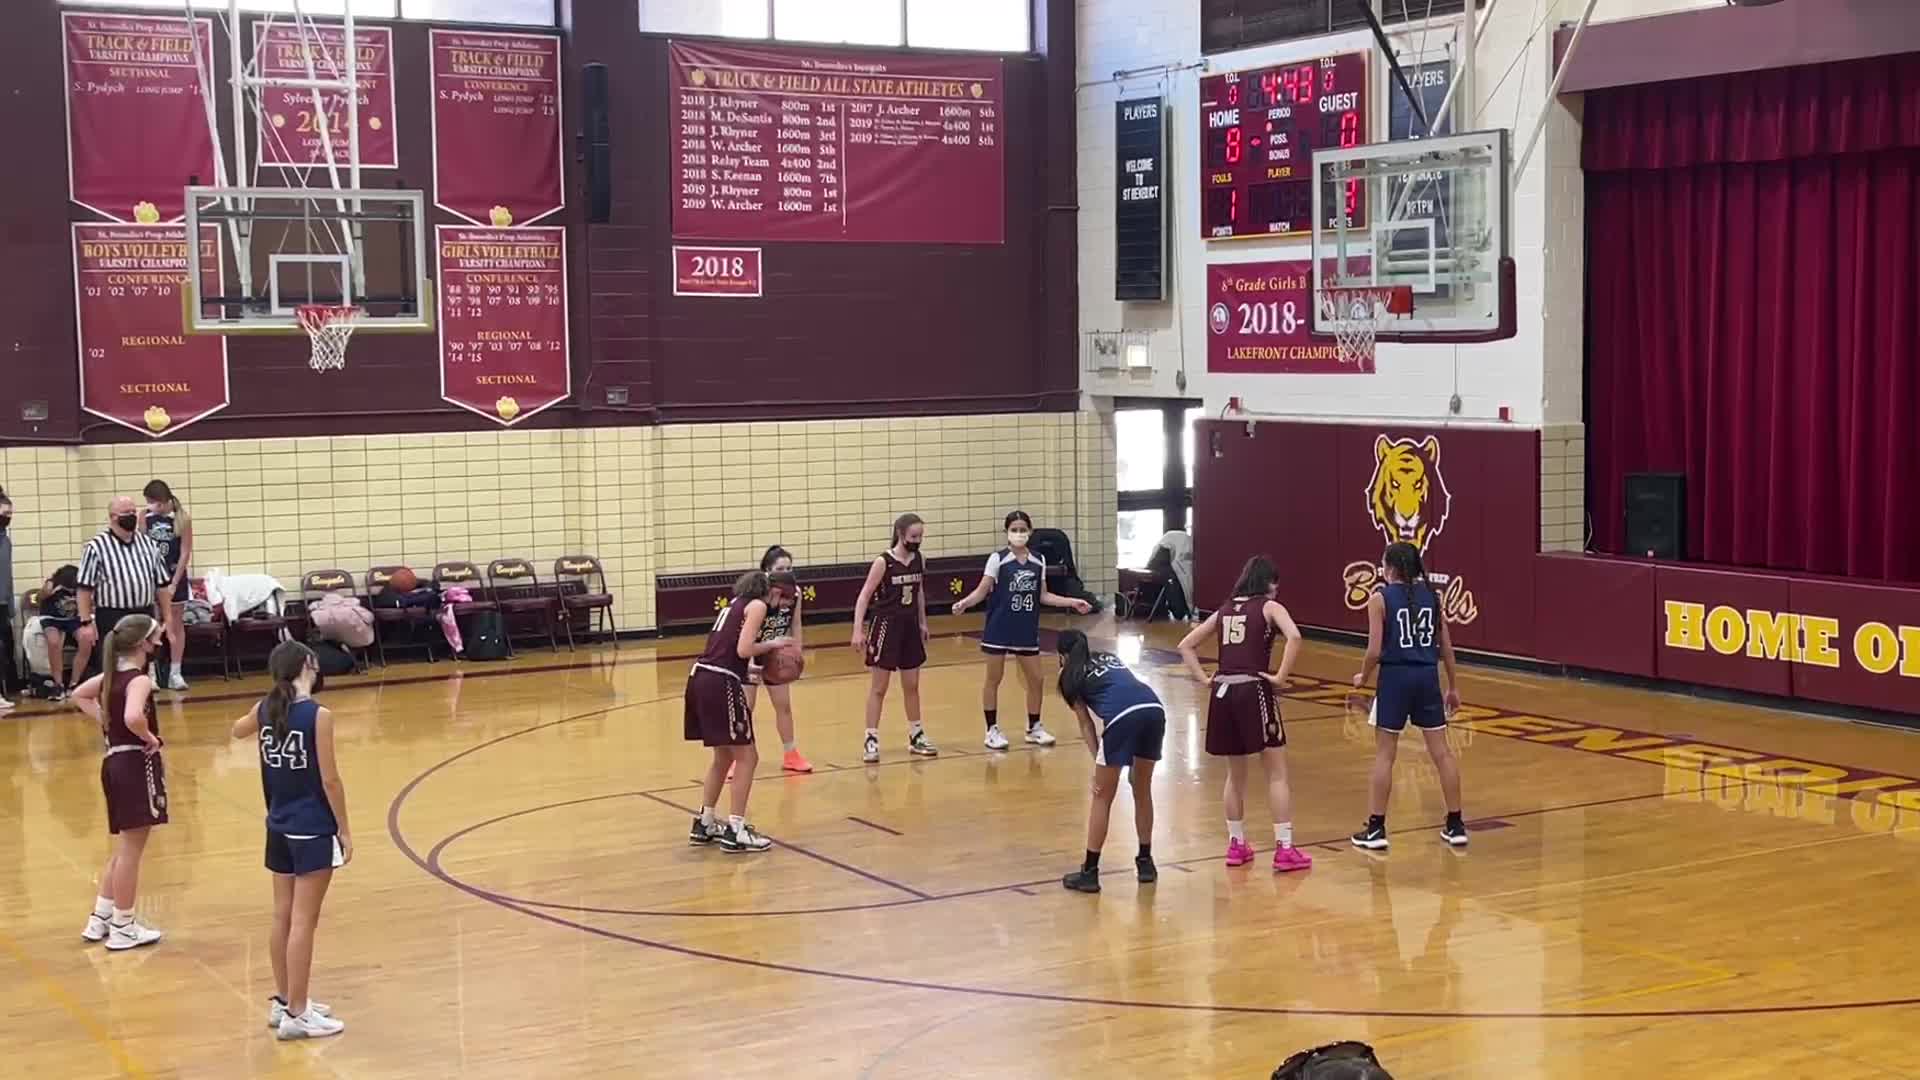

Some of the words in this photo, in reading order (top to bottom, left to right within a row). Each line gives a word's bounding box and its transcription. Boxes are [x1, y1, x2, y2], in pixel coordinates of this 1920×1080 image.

[87, 35, 134, 50] TRACK
[136, 38, 149, 50] &
[151, 38, 193, 53] FIELD
[89, 50, 130, 61] VARSITY
[131, 51, 190, 63] CHAMPIONS
[450, 51, 493, 65] TRACK
[495, 54, 505, 65] &
[507, 54, 544, 67] FIELD
[109, 67, 171, 79] SECTIONAL
[453, 64, 488, 74] VARSITY
[489, 65, 541, 77] CHAMPIONS
[73, 82, 85, 92] S.
[464, 80, 528, 92] CONFERENCE
[714, 72, 760, 87] TRACK
[763, 75, 776, 88] &
[779, 75, 821, 91] FIELD
[823, 77, 850, 93] ALL
[853, 79, 894, 94] STATE
[895, 80, 964, 97] ATHLETES
[1262, 66, 1314, 105] 4:43
[440, 90, 448, 99] S.
[681, 95, 705, 105] 2018
[709, 97, 718, 109] J.
[720, 97, 759, 109] Rhyner
[781, 101, 810, 111] 800m
[822, 103, 836, 112] 1st
[1319, 92, 1359, 112] GUEST
[681, 110, 705, 120] 2018
[711, 112, 725, 121] M.
[727, 112, 772, 123] DeSantis
[782, 116, 810, 125] 800m
[816, 117, 836, 126] 2nd
[851, 104, 873, 114] 2017
[876, 104, 884, 116] J.
[886, 104, 920, 116] Archer
[939, 106, 971, 117] 1600m
[979, 107, 995, 118] 5th
[1124, 104, 1157, 120] PLAYERS
[1268, 107, 1291, 120] PERIOD
[850, 118, 872, 128] 2019
[981, 122, 994, 132] 1st
[1209, 109, 1240, 128] HOME
[681, 125, 705, 135] 2018
[710, 126, 718, 137] J.
[720, 126, 758, 138] Rhyner
[777, 129, 810, 140] 1600m
[819, 131, 836, 141] 3rd
[1340, 112, 1359, 148] 0
[850, 133, 872, 143] 2019
[978, 136, 994, 146] 5th
[682, 139, 705, 149] 2018
[712, 141, 725, 151] W.
[728, 141, 762, 152] Archer
[777, 143, 811, 154] 1600m
[819, 145, 836, 155] 5th
[682, 154, 706, 164] 2018
[711, 155, 740, 168] Relay
[742, 156, 770, 167] Team
[817, 159, 837, 169] 2nd
[1125, 158, 1153, 173] WELCOME
[682, 169, 706, 179] 2018
[711, 170, 721, 180] S.
[778, 172, 811, 183] 1600m
[820, 173, 837, 184] 7th
[1212, 172, 1233, 184] FOULS
[1268, 166, 1291, 178] PLAYER
[1135, 173, 1144, 186] TO
[682, 184, 706, 194] 2019
[710, 185, 718, 197] J.
[721, 185, 760, 197] Rhyner
[783, 187, 811, 197] 800m
[823, 188, 837, 198] 1st
[682, 199, 706, 209] 2019
[712, 199, 725, 210] W.
[728, 200, 763, 211] Archer
[778, 201, 812, 212] 1600m
[823, 202, 837, 212] 1st
[1329, 217, 1352, 228] POTS
[83, 243, 121, 258] BOYS
[123, 243, 216, 258] VOLLEYBLL
[442, 245, 480, 258] GIRLS
[483, 245, 560, 259] VOLLEYBALL
[99, 258, 139, 268] VARSITY
[141, 258, 187, 268] CHAMPIO
[459, 259, 494, 268] VARSITY
[495, 259, 547, 269] CHAMPIONS
[691, 256, 744, 277] 2018
[466, 274, 538, 283] CONFERENCE
[1236, 278, 1266, 292] Grade
[1269, 276, 1296, 291] Girls
[121, 336, 185, 346] REGIONAL
[477, 331, 533, 341] REGIONAL
[89, 348, 105, 358] '02
[1227, 347, 1288, 360] LAKEFRONT
[476, 375, 537, 384] SECTIONAL
[119, 383, 191, 393] SECTIONAL
[901, 585, 913, 605] 5
[1011, 593, 1034, 612] 34
[1222, 614, 1248, 645] 15
[1397, 607, 1434, 648] 14
[1664, 600, 1840, 668] HOME
[259, 726, 307, 770] 24
